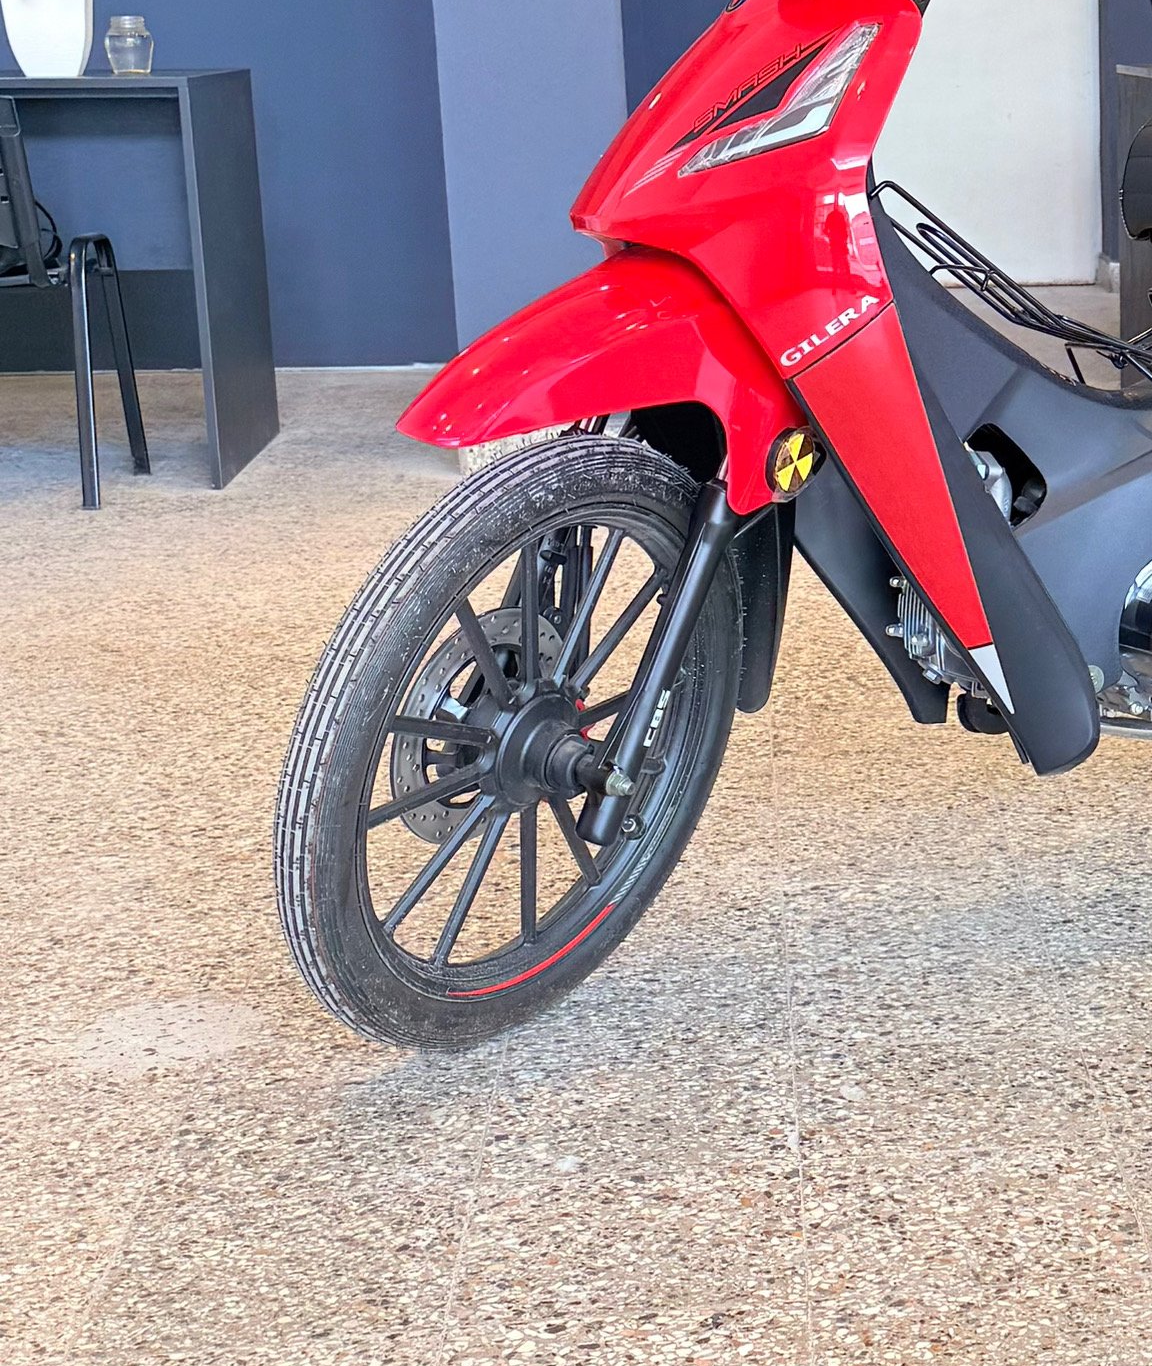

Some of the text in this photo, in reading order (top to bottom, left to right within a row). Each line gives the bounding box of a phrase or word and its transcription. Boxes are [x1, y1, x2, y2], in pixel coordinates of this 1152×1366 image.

[693, 43, 802, 132] SMASH
[780, 295, 880, 367] GILERA
[643, 690, 671, 747] CBS
